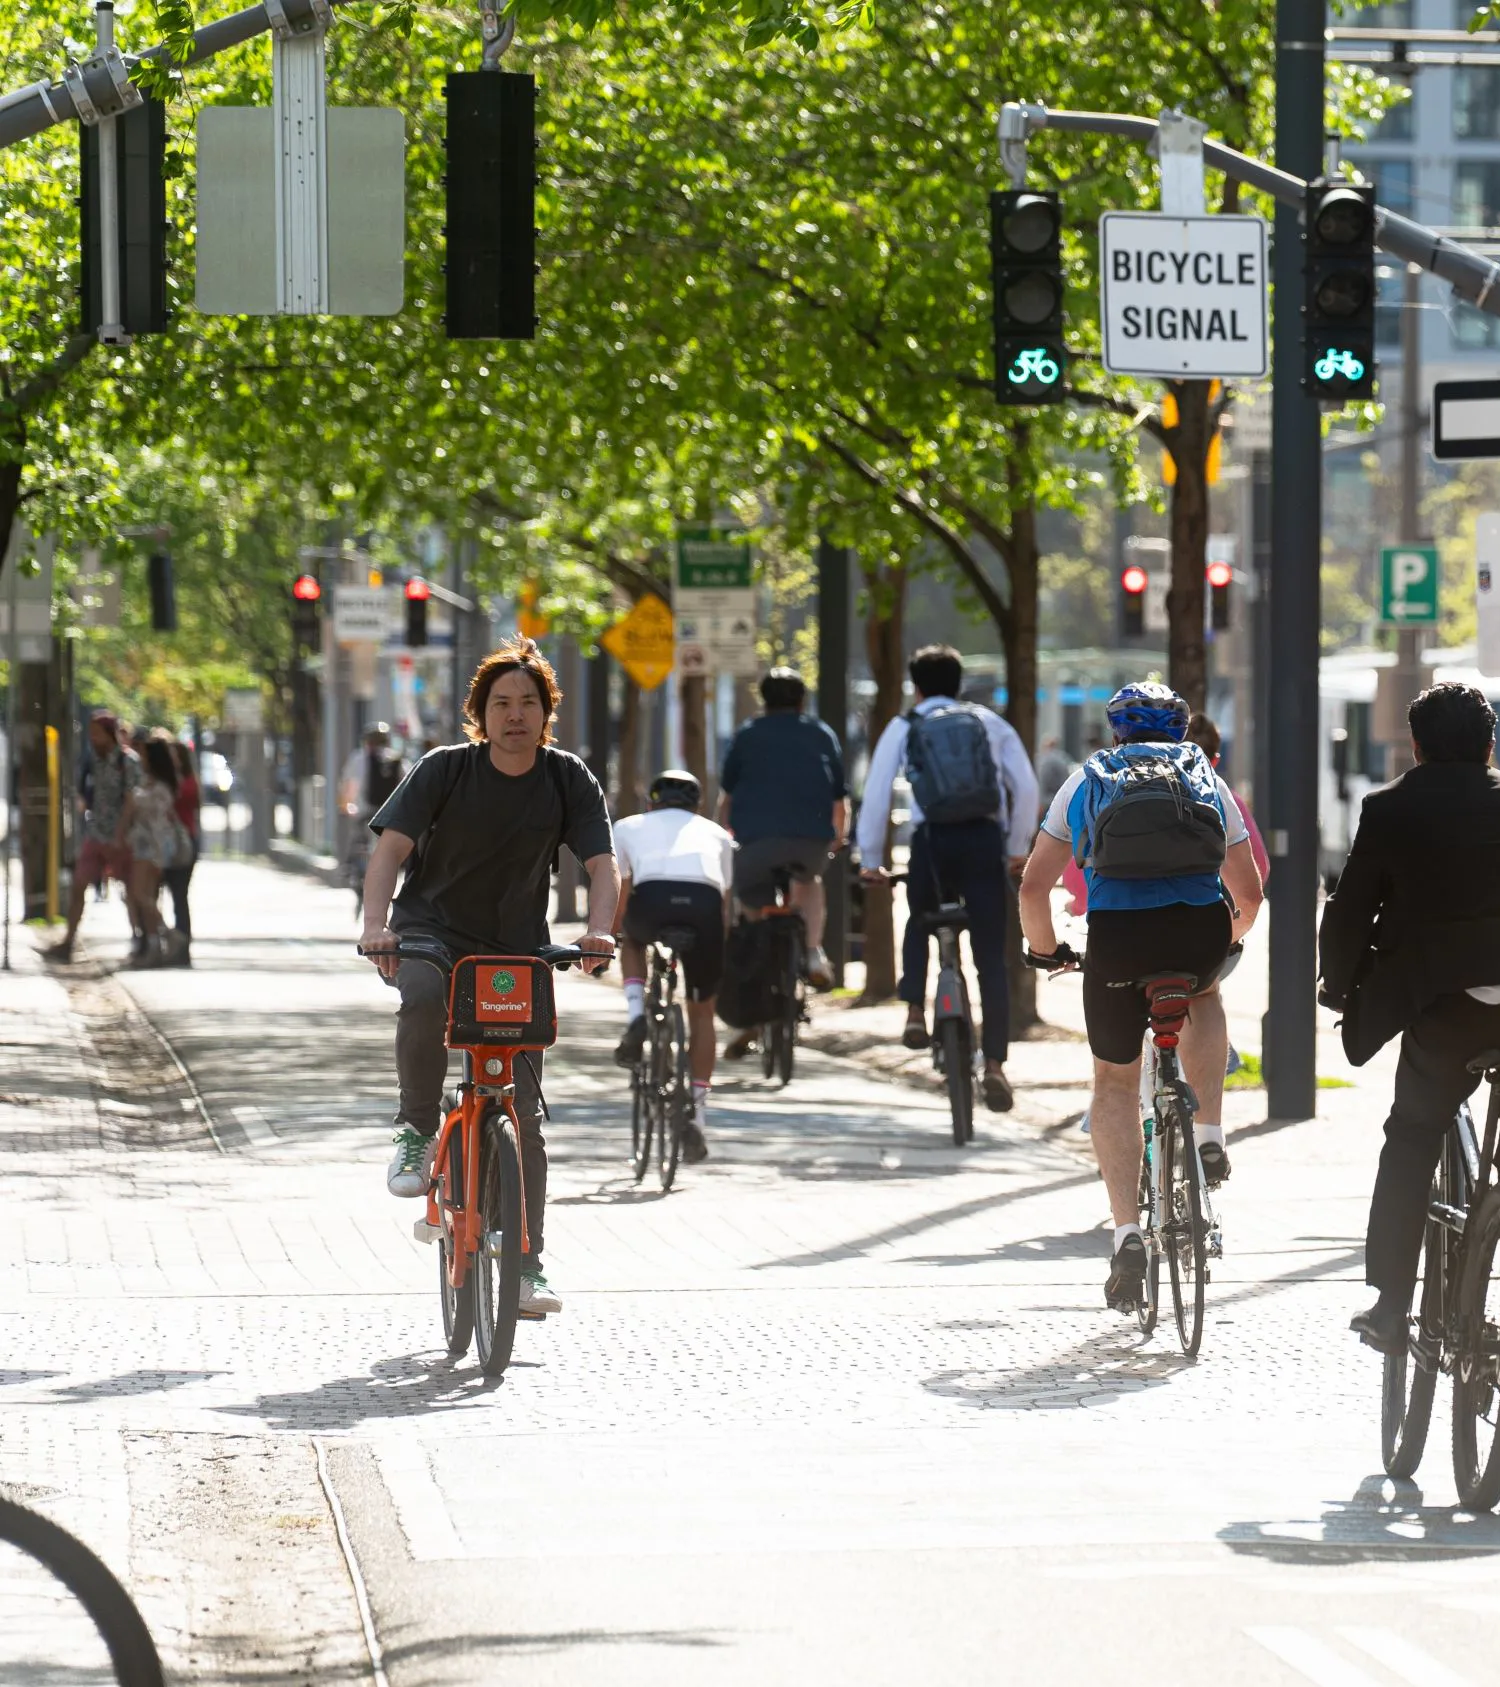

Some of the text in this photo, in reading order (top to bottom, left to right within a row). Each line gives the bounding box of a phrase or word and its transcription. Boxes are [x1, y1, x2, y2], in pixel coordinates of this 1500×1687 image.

[1112, 249, 1256, 286] BICYCLE
[1121, 305, 1249, 342] SIGNAL
[1391, 553, 1428, 598] P
[480, 1001, 523, 1013] Tangerine
